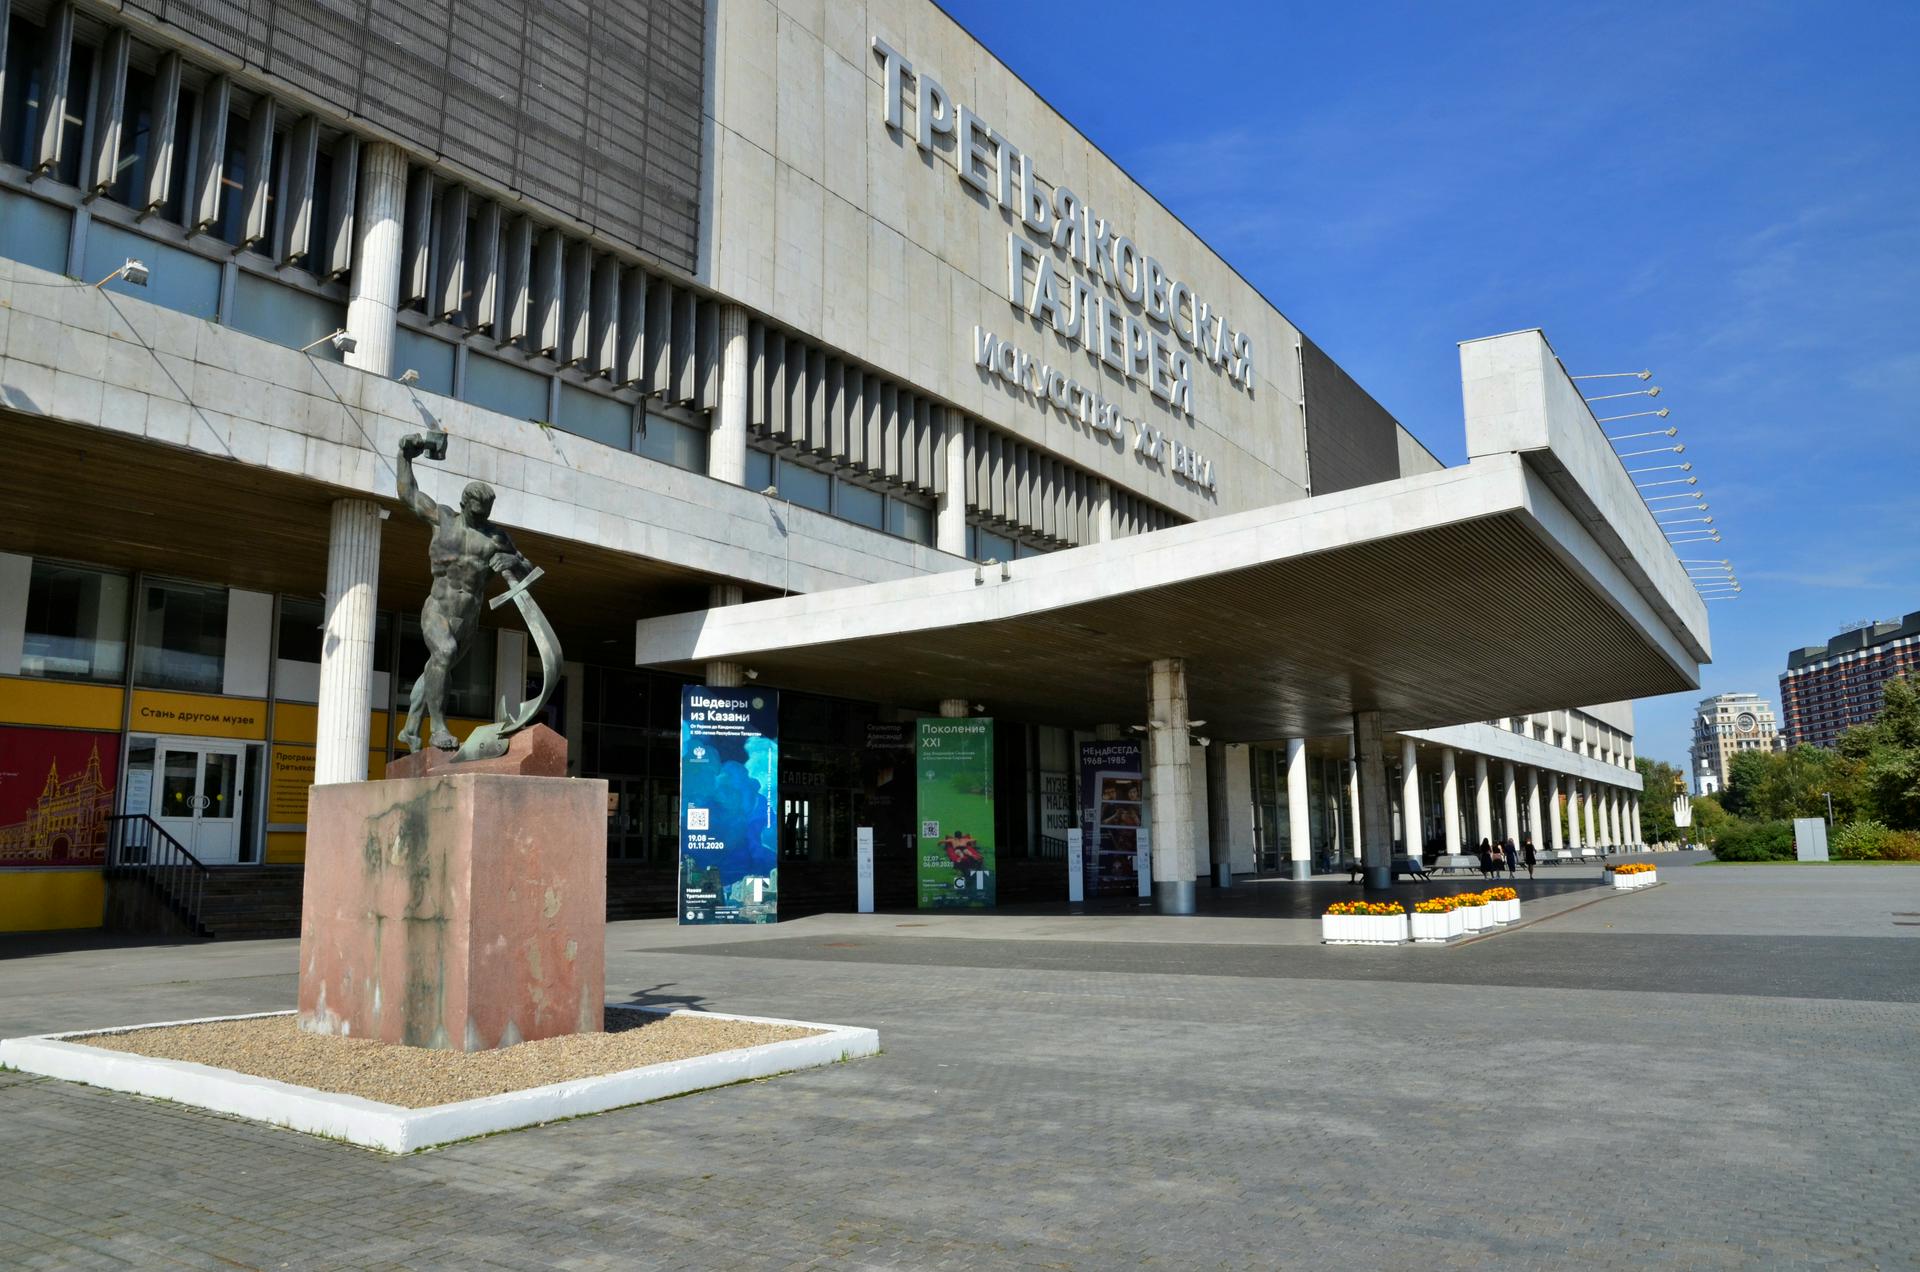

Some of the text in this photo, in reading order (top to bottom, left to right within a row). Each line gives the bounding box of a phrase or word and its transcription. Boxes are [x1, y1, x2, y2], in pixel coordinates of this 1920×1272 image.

[872, 35, 1255, 392] ТРЕТЬЯКОВСКАЯ
[1007, 231, 1195, 418] ГАЛЕРЕЯ
[974, 325, 1124, 441] ИСКУССТВО
[1169, 440, 1217, 493] ВЕКА
[690, 696, 748, 710] Шедевры
[140, 707, 255, 726] Стань другом музея
[690, 710, 751, 722] из Казани
[922, 724, 986, 734] Поколение
[688, 842, 724, 850] 01.11.2020
